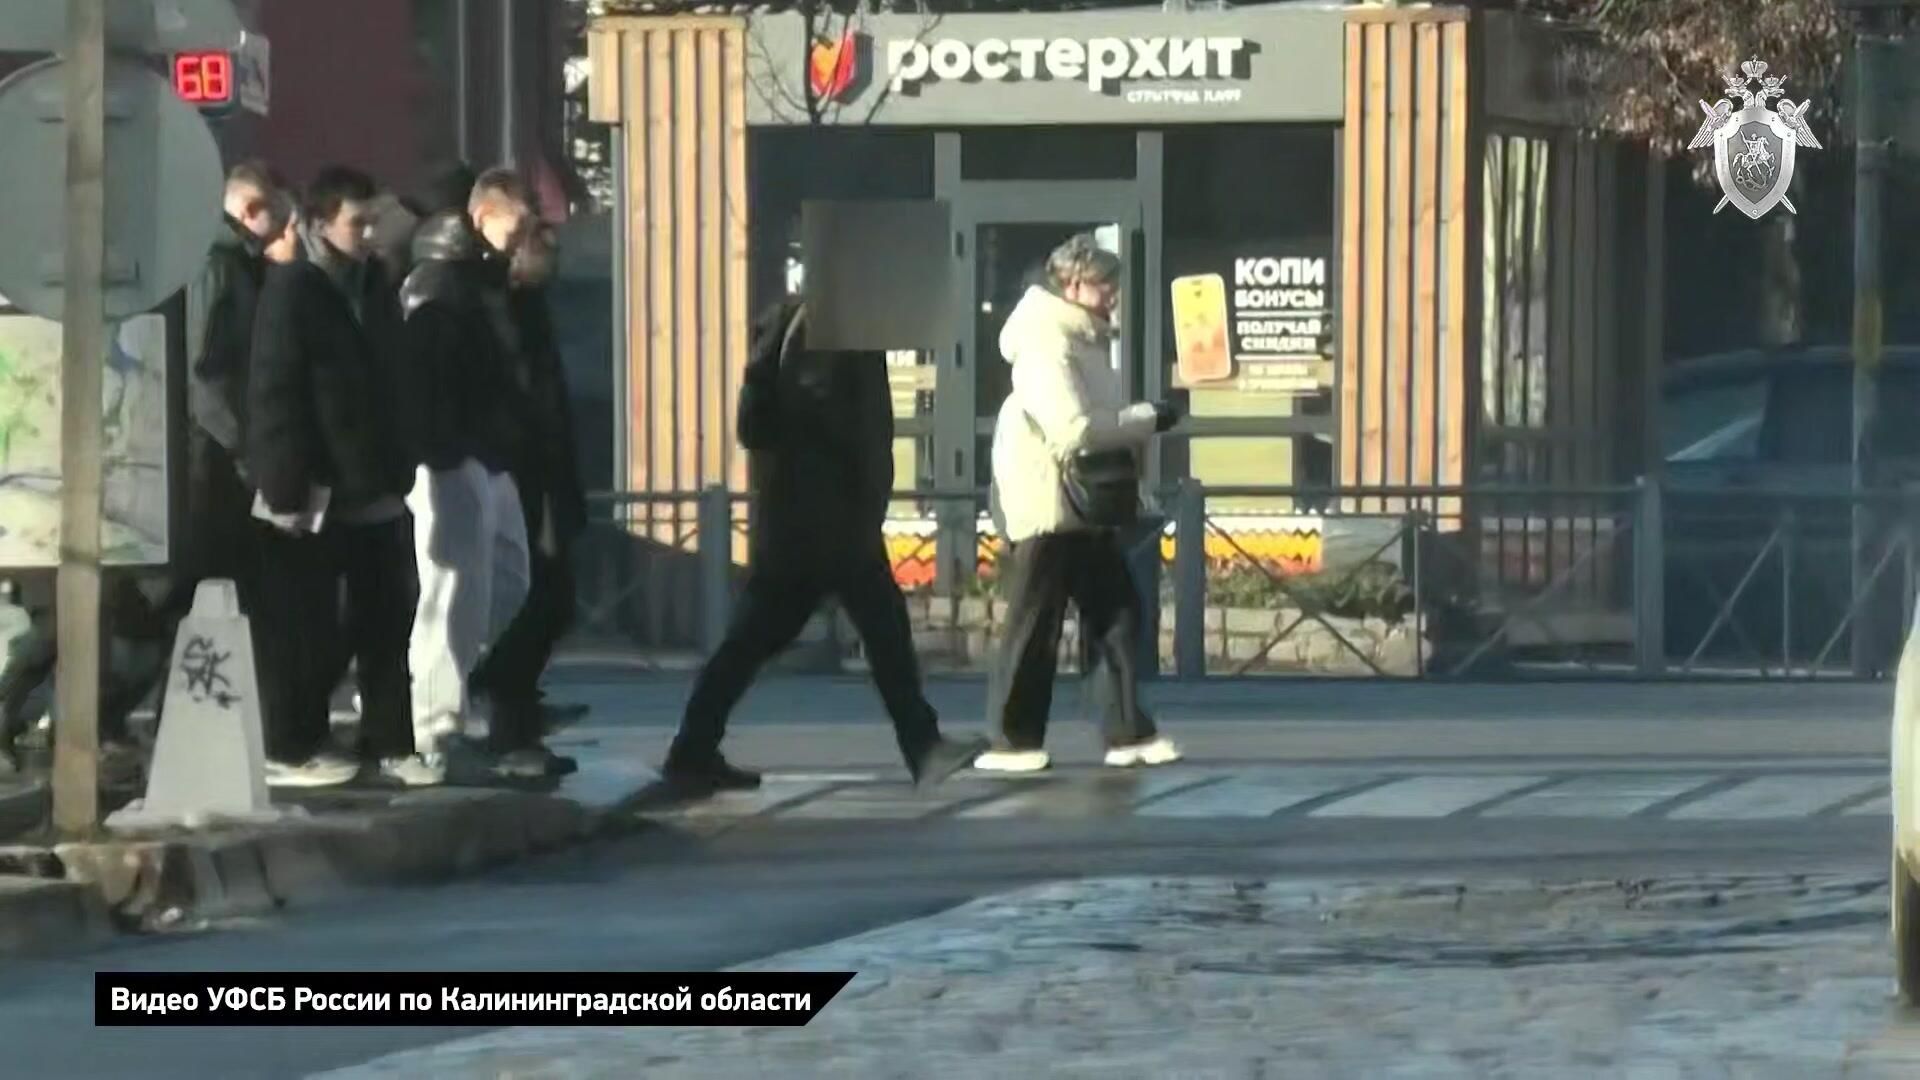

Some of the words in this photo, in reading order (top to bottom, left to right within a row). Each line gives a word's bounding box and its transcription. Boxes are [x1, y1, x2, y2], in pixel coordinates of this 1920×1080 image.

[176, 54, 229, 100] 68
[887, 36, 1243, 92] ростерхит
[1235, 258, 1325, 286] КОПИ
[1235, 289, 1325, 308] БОНУСЫ
[1237, 318, 1322, 335] ПОЛУЧАЙ
